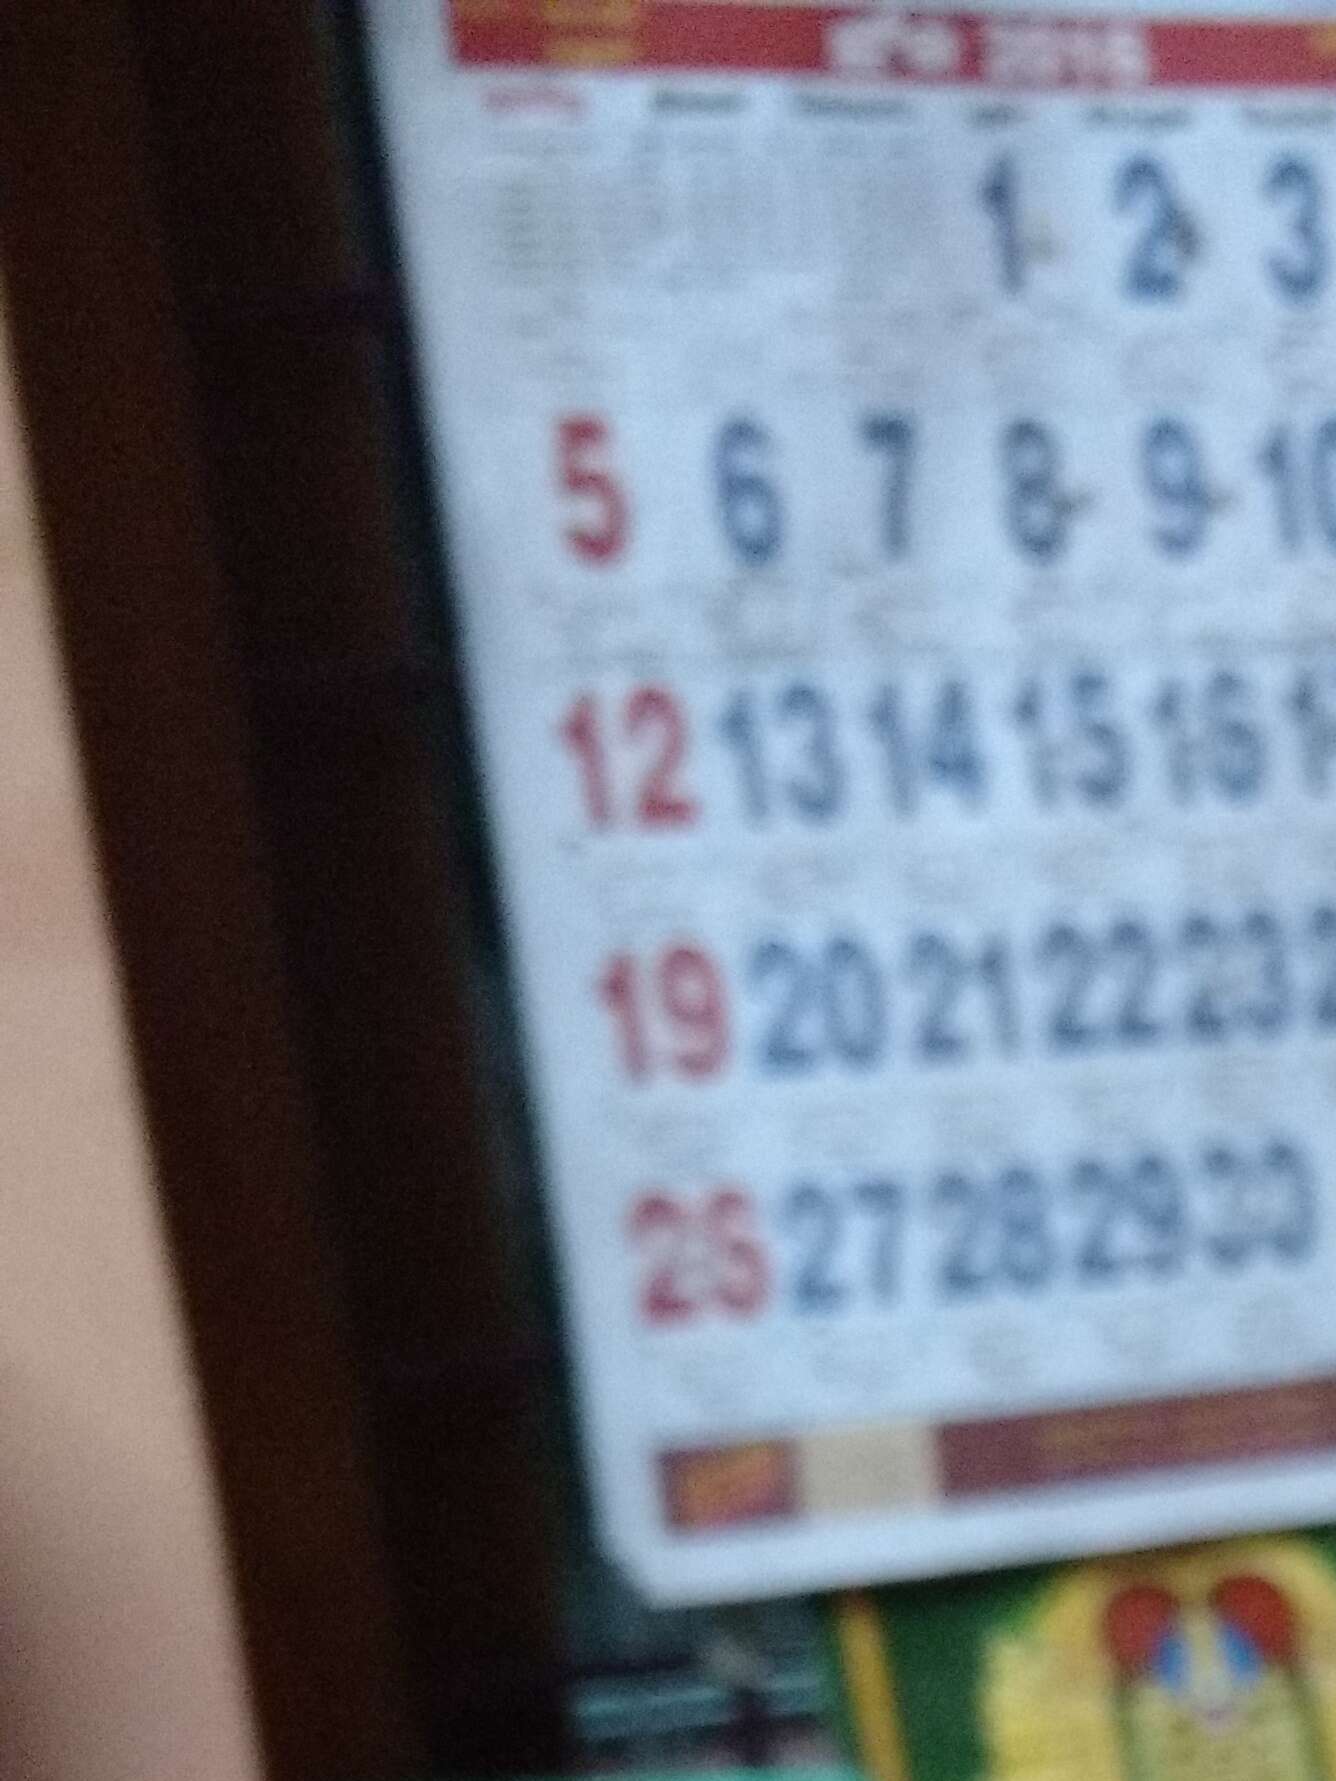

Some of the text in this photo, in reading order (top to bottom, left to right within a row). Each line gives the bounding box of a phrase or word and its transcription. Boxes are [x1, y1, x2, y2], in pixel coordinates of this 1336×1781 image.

[977, 148, 1024, 294] 1
[1112, 152, 1202, 302] 2
[1262, 152, 1331, 303] 3
[553, 410, 631, 569] 5
[713, 412, 786, 572] 6
[858, 407, 919, 558] 7
[997, 412, 1070, 568] 8
[1138, 412, 1206, 564] 9
[557, 681, 697, 830] 12
[716, 682, 846, 826] 13
[864, 674, 987, 814] 14
[1010, 660, 1132, 810] 15
[1149, 661, 1270, 805] 16
[592, 938, 730, 1084] 19
[744, 929, 891, 1078] 20
[900, 927, 1022, 1067] 21
[1042, 918, 1160, 1054] 22
[1178, 907, 1292, 1044] 23
[786, 1176, 908, 1316] 27
